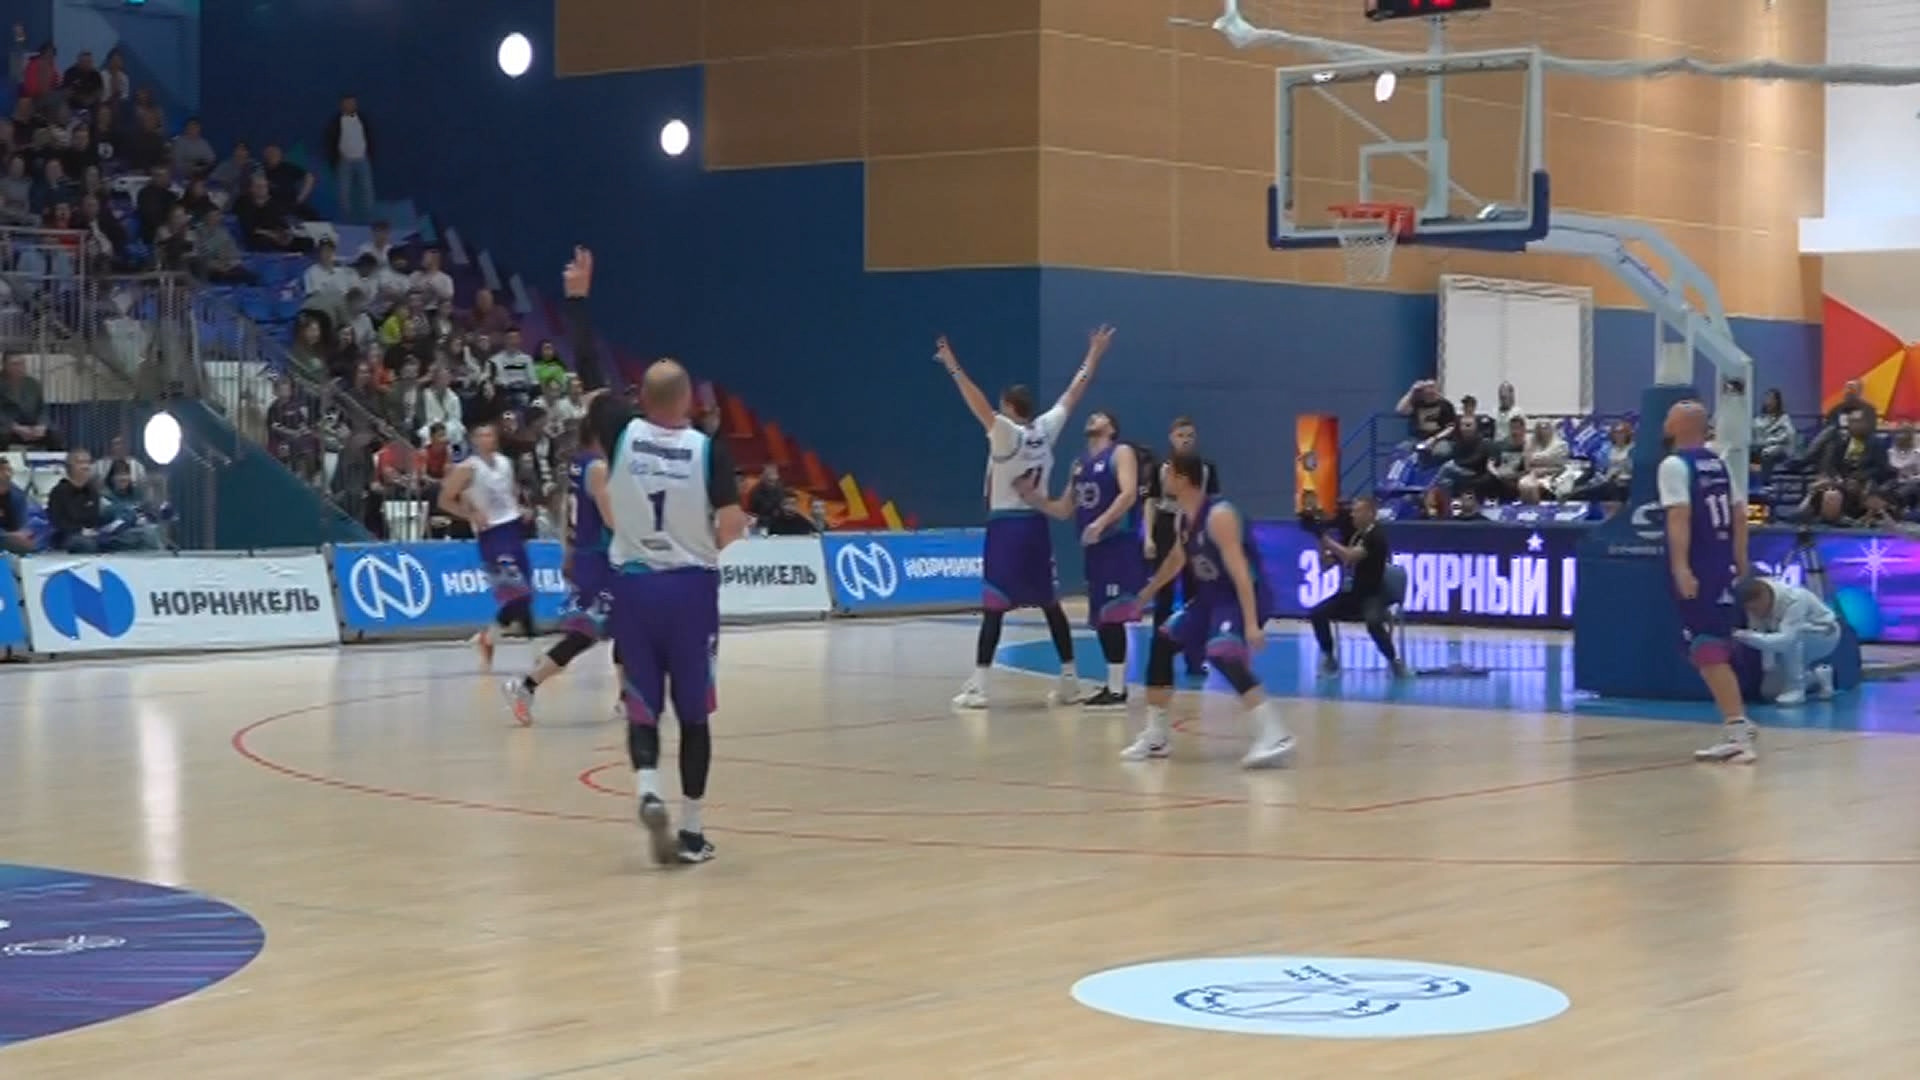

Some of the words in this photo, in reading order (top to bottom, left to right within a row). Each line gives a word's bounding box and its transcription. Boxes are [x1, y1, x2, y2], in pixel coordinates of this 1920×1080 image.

[647, 490, 666, 531] 1
[1705, 494, 1731, 528] 11
[722, 564, 817, 586] РНИКЕЛЬ
[1298, 535, 1548, 616] ЗЛЯРНЫЙ
[150, 587, 320, 616] НОРНИКЕЛЬ
